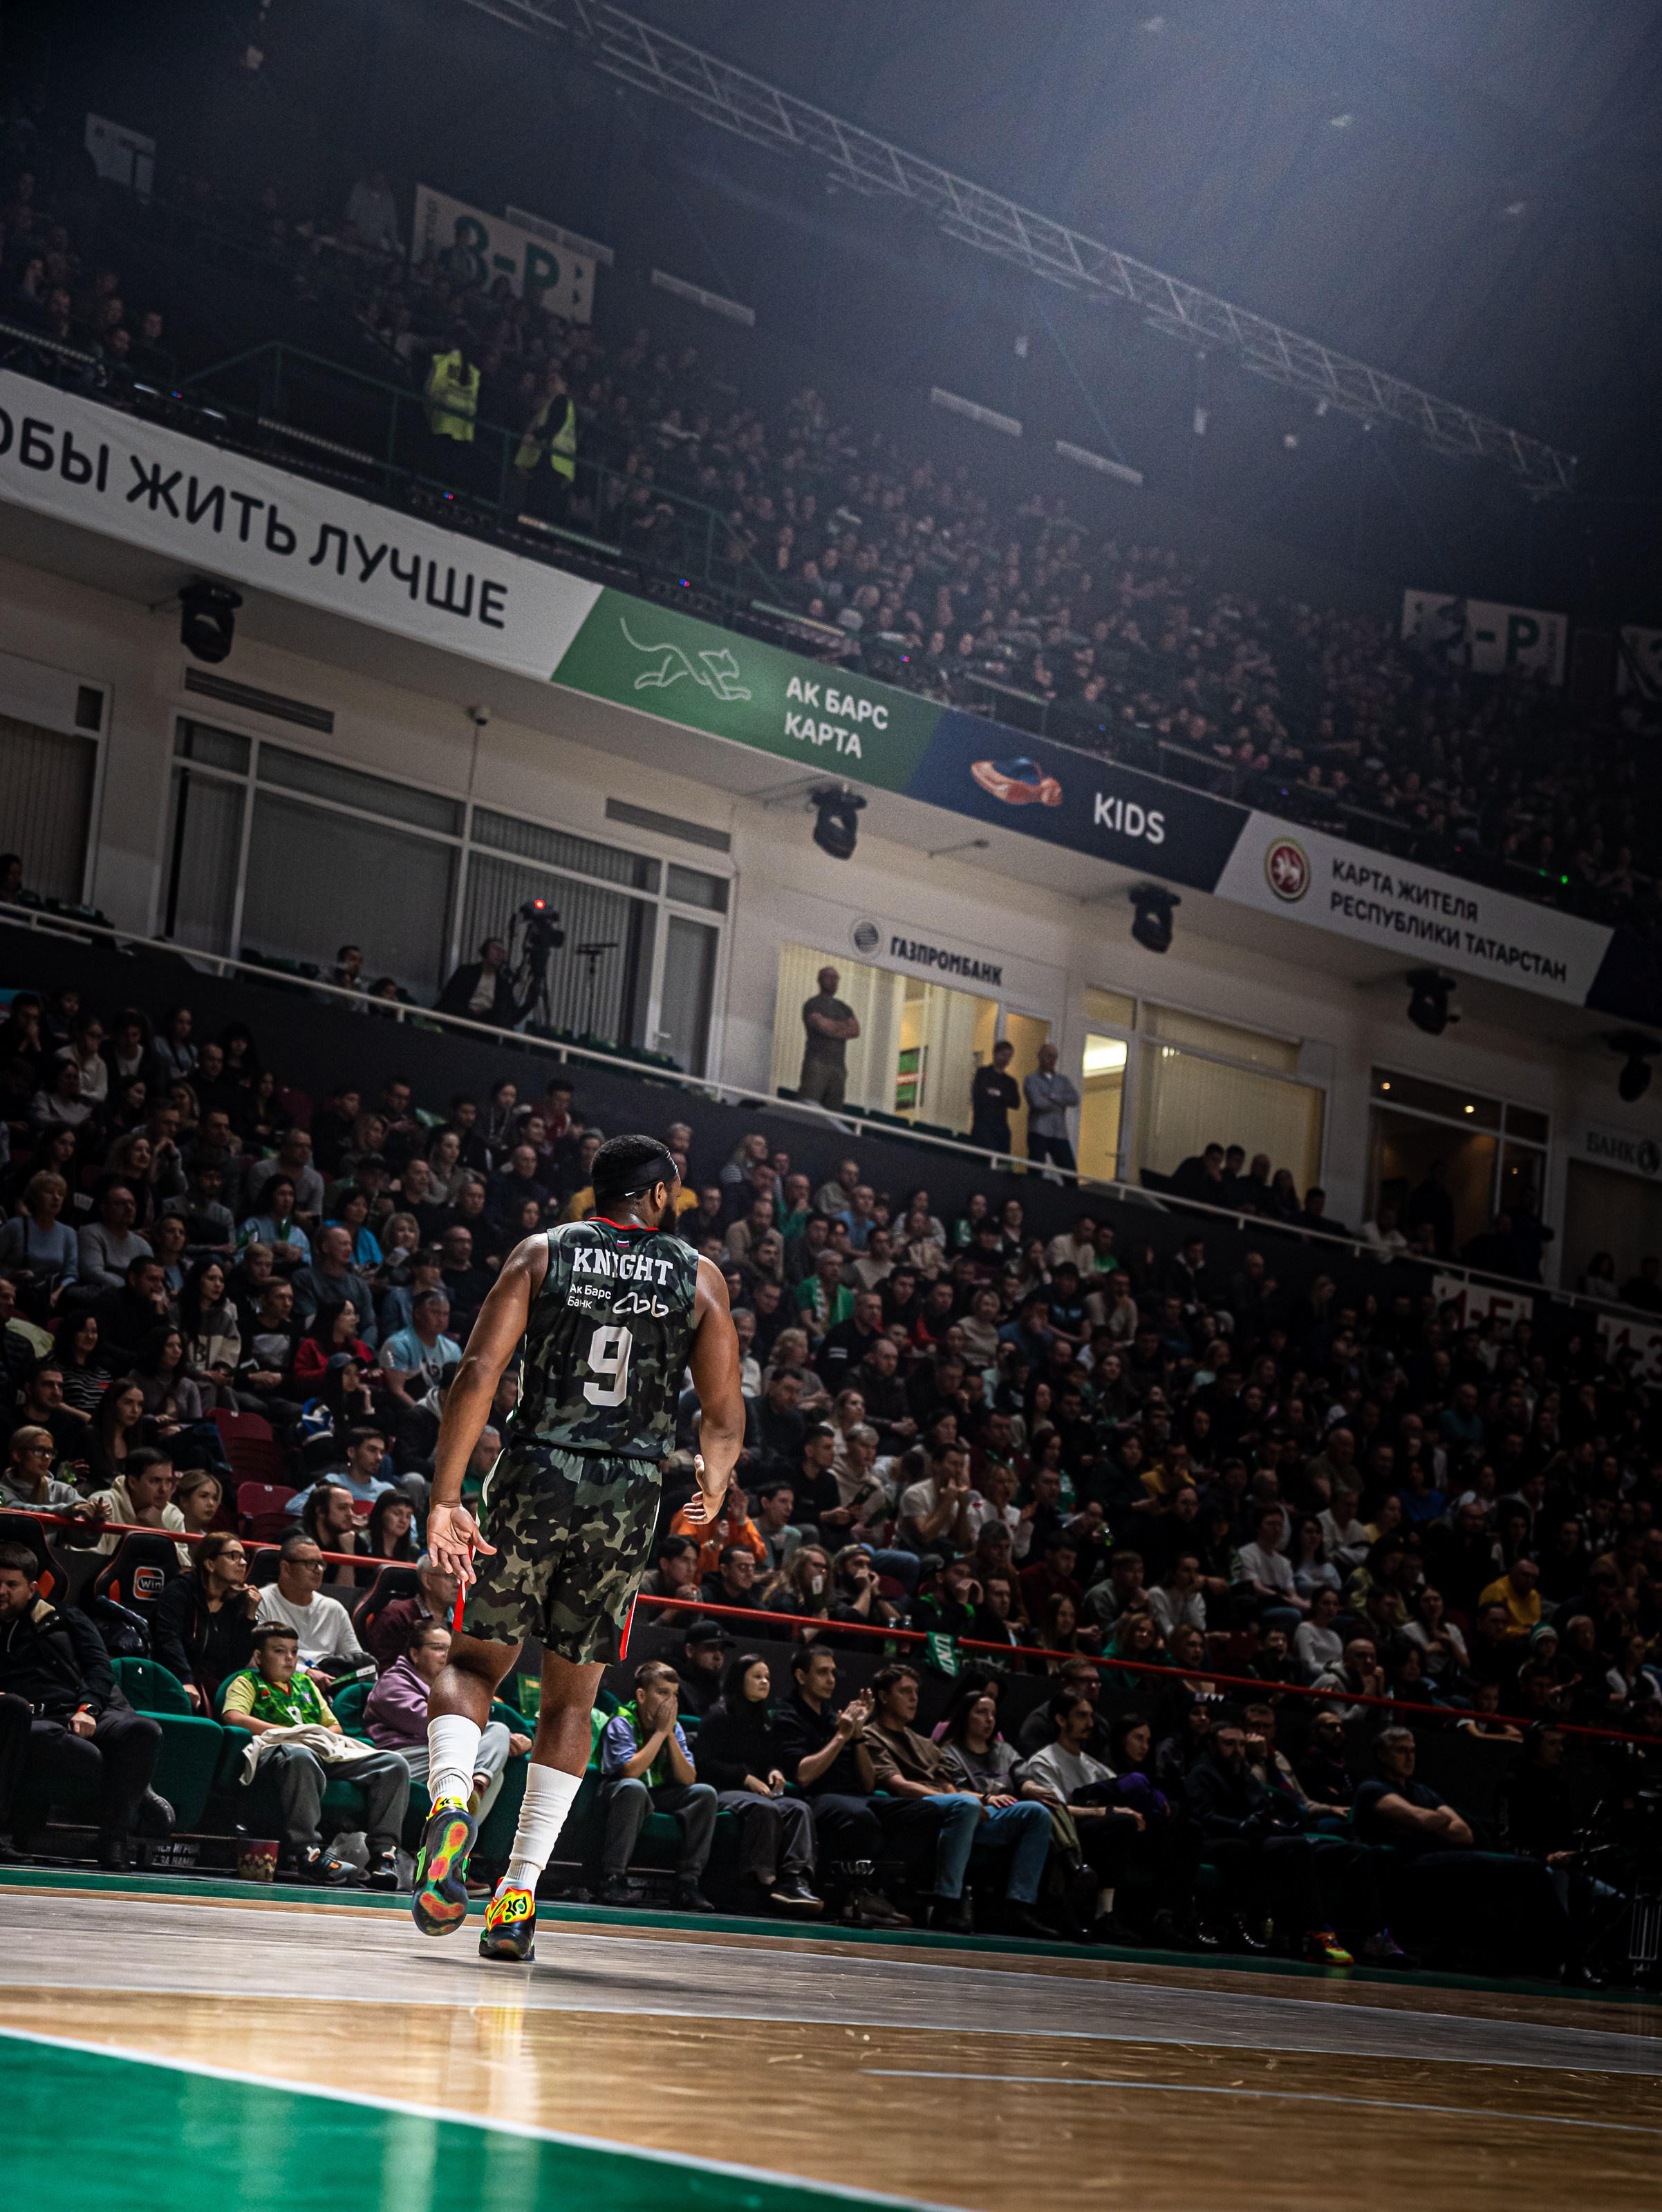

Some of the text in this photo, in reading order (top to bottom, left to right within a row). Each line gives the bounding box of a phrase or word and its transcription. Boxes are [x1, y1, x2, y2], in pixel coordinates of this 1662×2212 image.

[126, 454, 297, 556] ЖИТЬ
[308, 522, 508, 629] ЛУЧШЕ
[786, 676, 888, 730] АК БАРС
[784, 711, 862, 759] КАРТА
[1094, 791, 1166, 845] KIDS
[1332, 857, 1478, 924] КАРТА ЖИТЕЛЯ
[889, 936, 1002, 987] ГАЗПРОМБАНК
[1330, 892, 1567, 983] РЕСПУБЛИКИ ТАТАРСТАН
[1587, 1132, 1636, 1164] БАНК
[569, 1283, 611, 1300] Ак Барс
[572, 1246, 673, 1286] KNIGHT
[567, 1295, 592, 1310] Банк
[583, 1324, 633, 1407] 9
